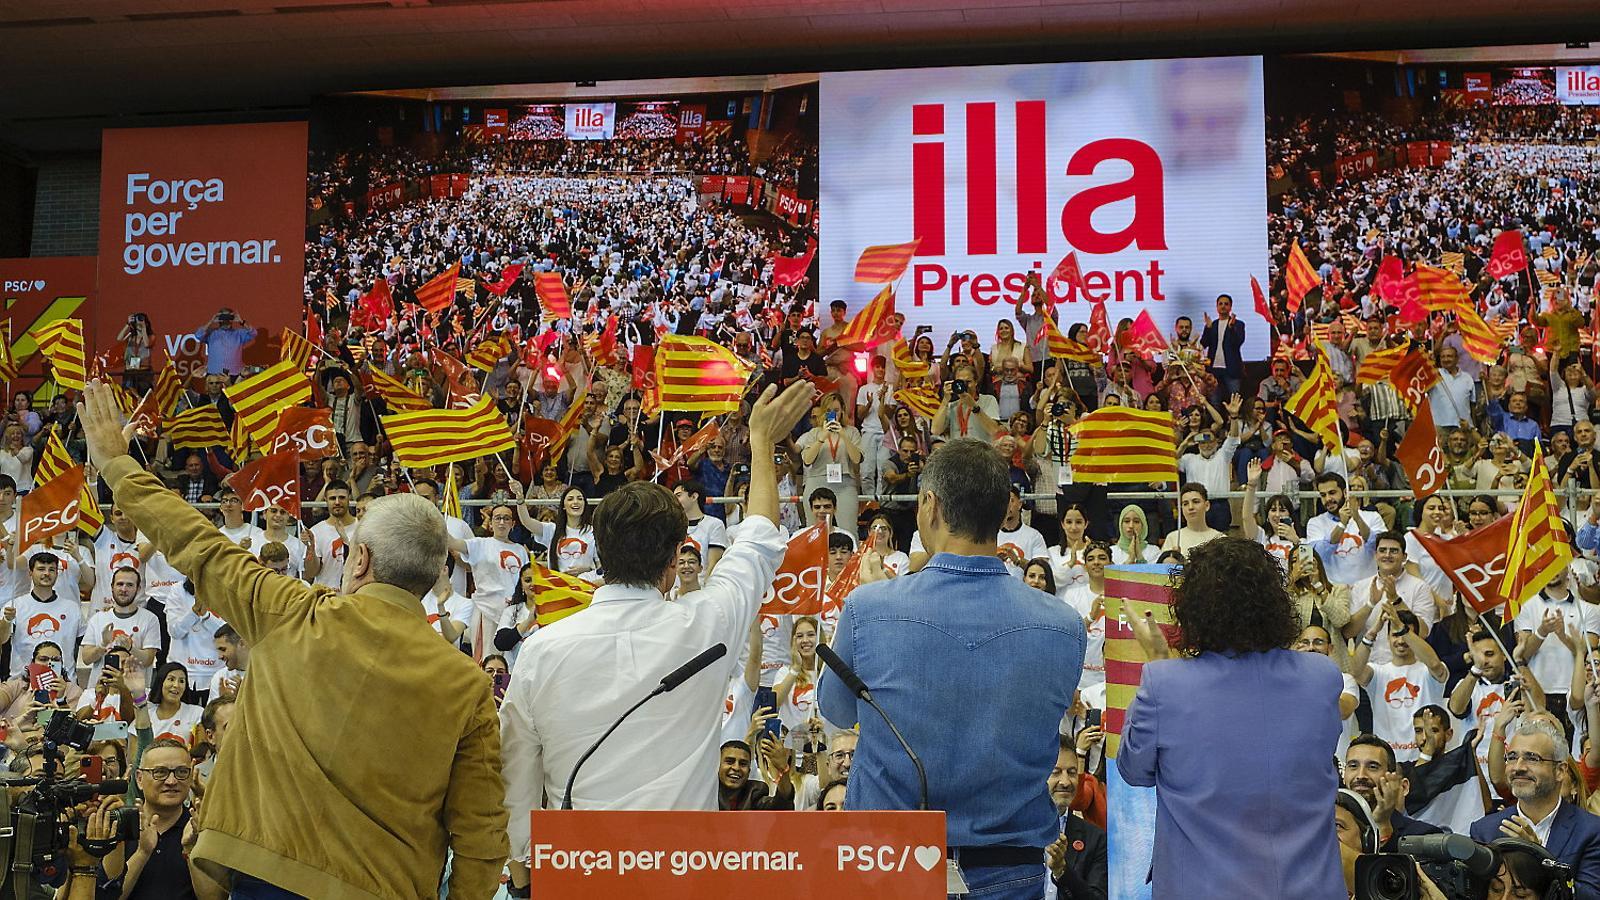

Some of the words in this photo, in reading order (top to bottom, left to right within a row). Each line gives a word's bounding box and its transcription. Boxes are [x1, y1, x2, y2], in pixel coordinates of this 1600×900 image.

[1567, 71, 1600, 91] illa
[575, 108, 604, 127] illa
[126, 173, 224, 209] Força
[913, 100, 1168, 256] illa
[125, 211, 182, 242] per
[123, 239, 281, 275] governar.
[913, 260, 1165, 307] President
[164, 333, 209, 357] VO
[635, 366, 656, 389] PS
[273, 424, 330, 454] PSC
[25, 500, 79, 542] PSC
[534, 843, 612, 875] Força
[618, 849, 665, 875] per
[671, 849, 803, 876] governar.
